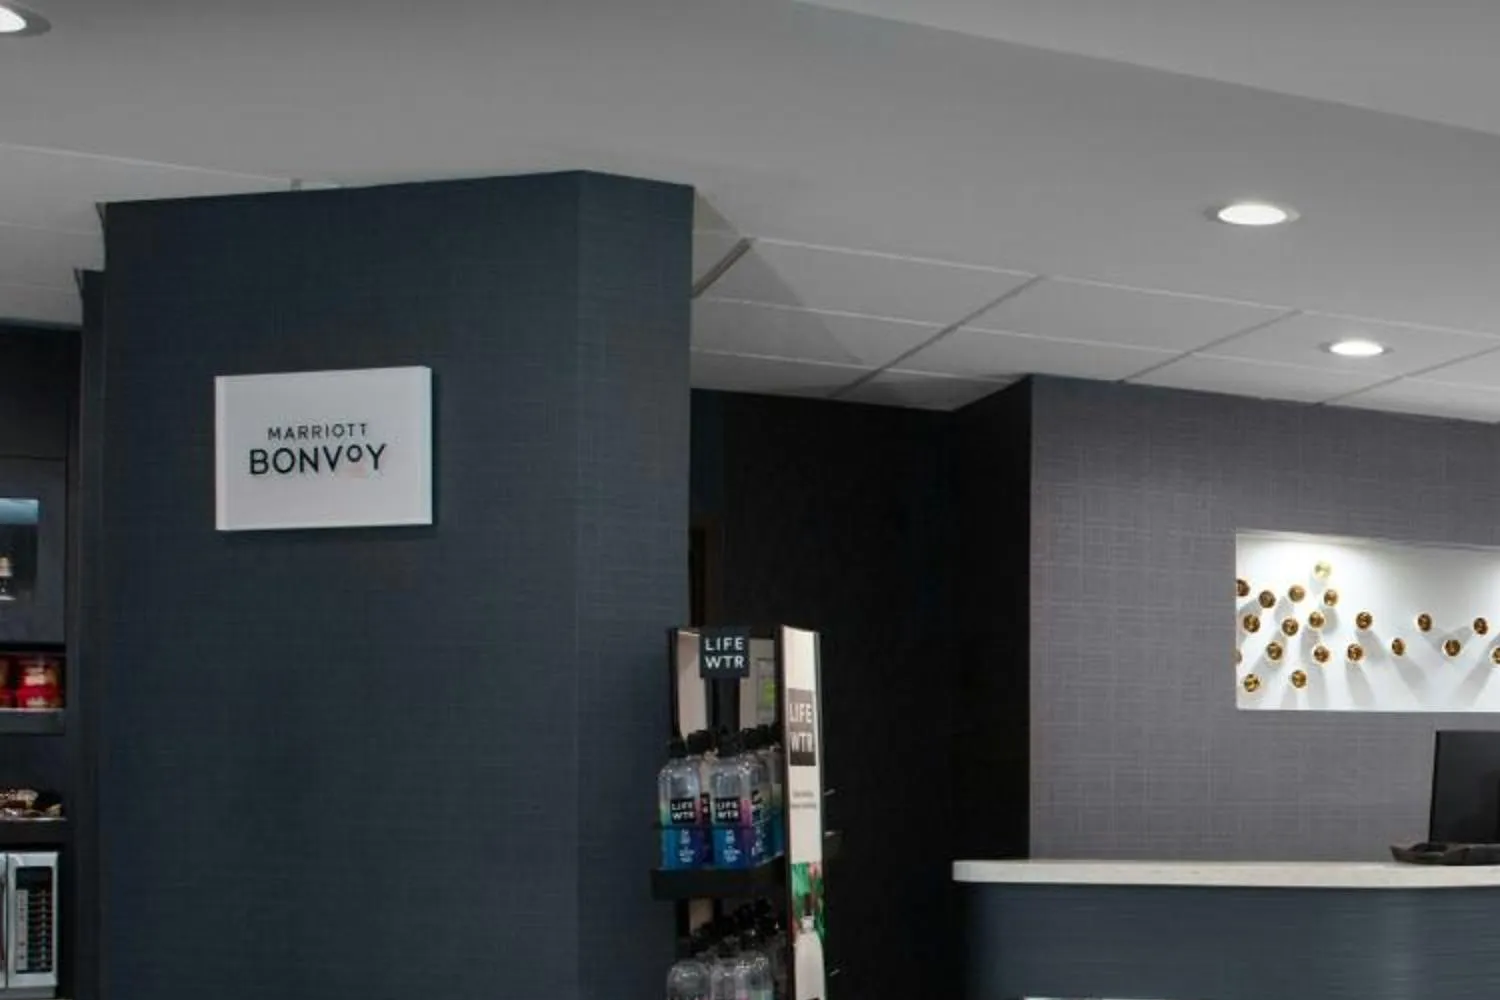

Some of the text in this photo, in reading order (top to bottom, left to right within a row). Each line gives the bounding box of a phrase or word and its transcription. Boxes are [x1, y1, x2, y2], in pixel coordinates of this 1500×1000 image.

[267, 423, 368, 441] MARRIOTT
[249, 443, 387, 475] BONVOY
[704, 637, 745, 651] LIFE
[704, 655, 745, 669] WTR
[789, 703, 813, 724] LIFE
[790, 731, 814, 753] WTR
[671, 801, 693, 811] LIFE
[671, 811, 695, 821] WTR
